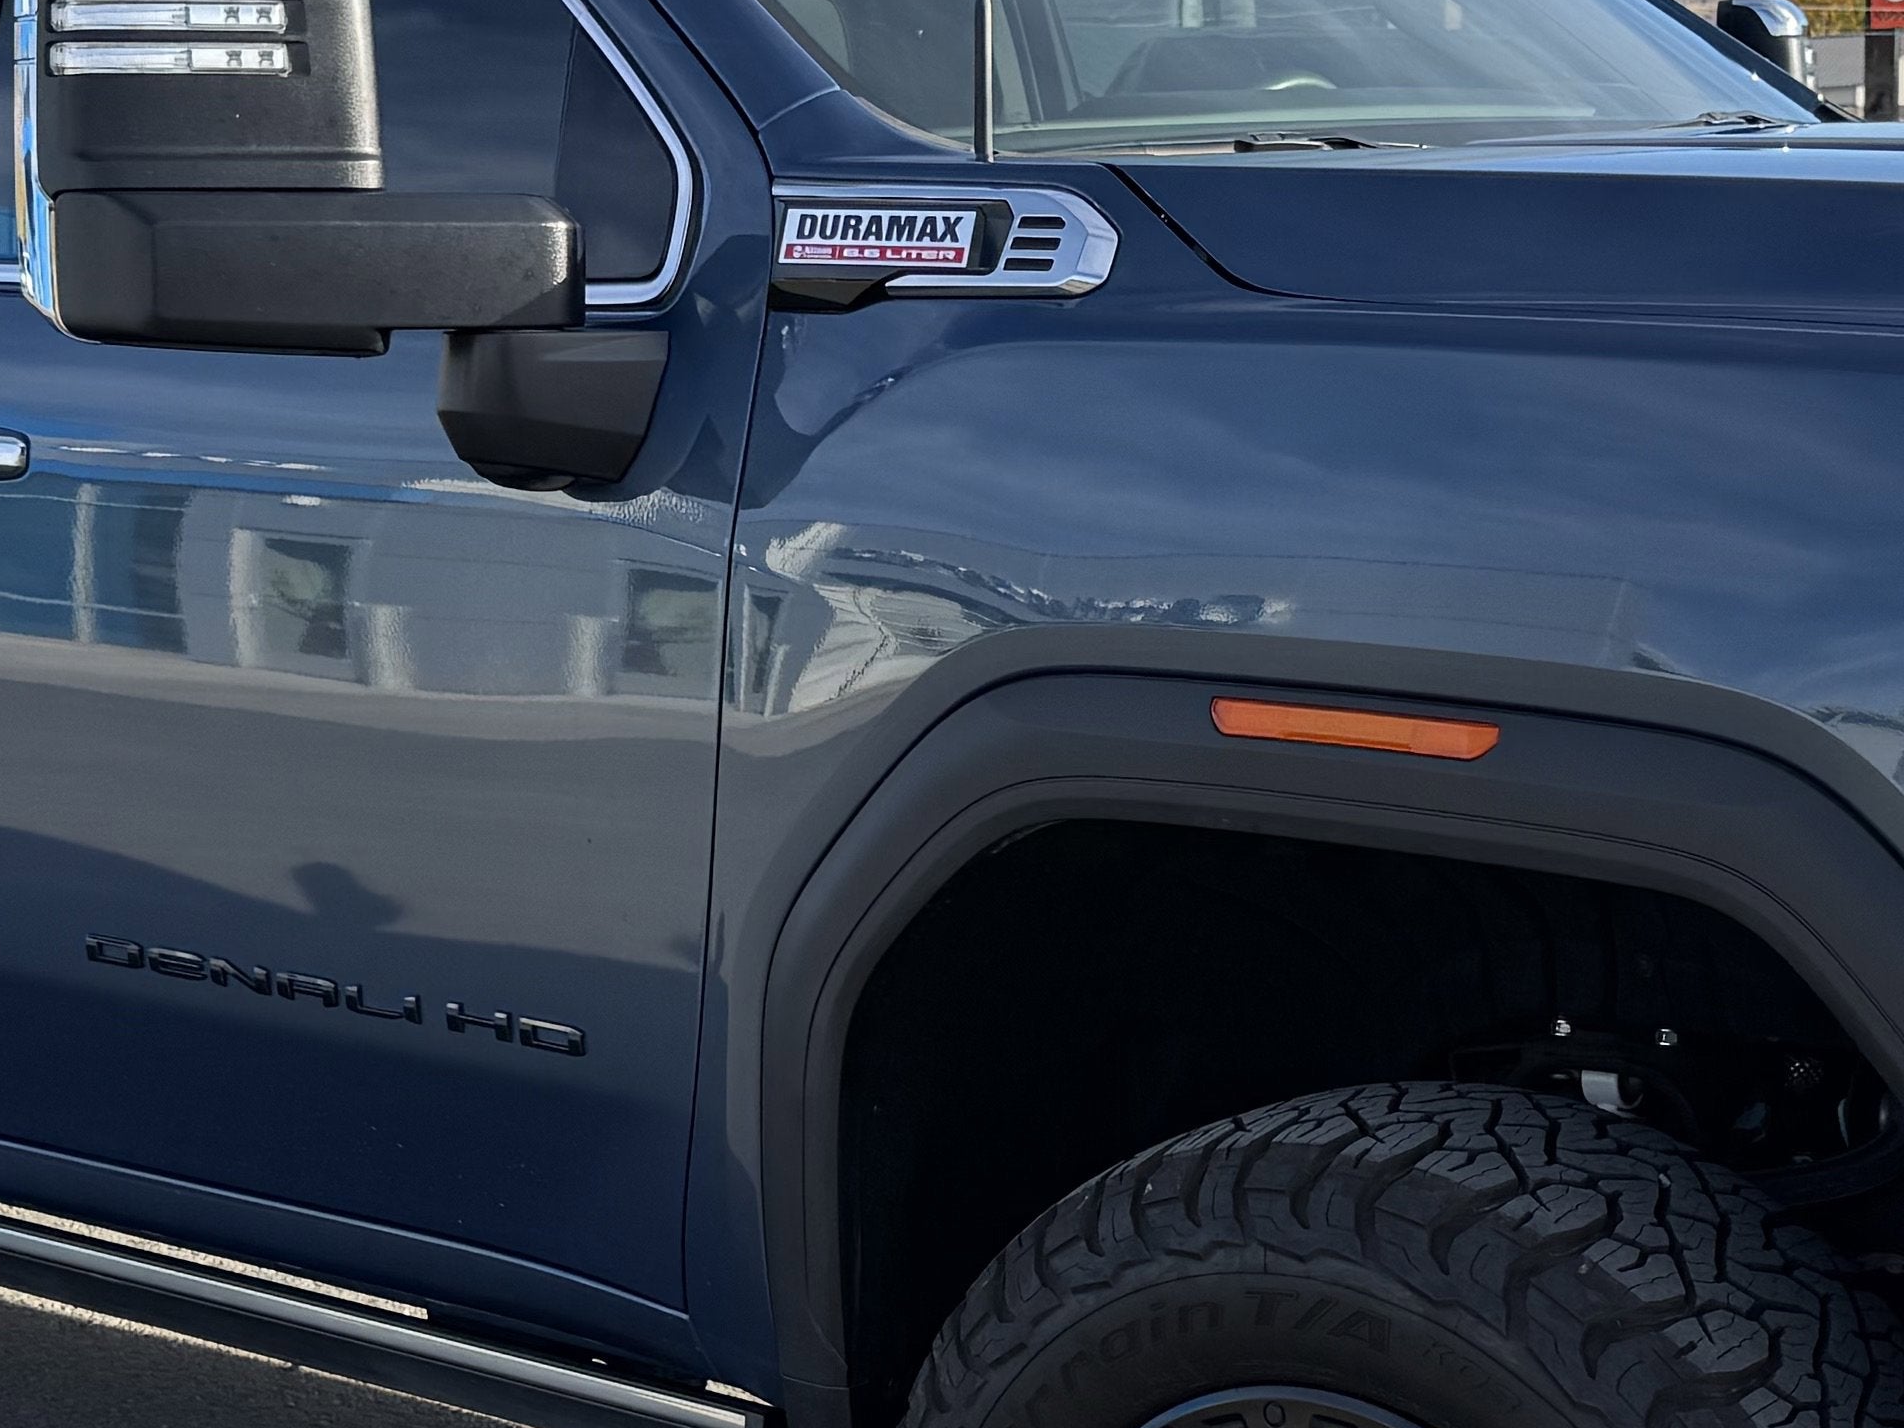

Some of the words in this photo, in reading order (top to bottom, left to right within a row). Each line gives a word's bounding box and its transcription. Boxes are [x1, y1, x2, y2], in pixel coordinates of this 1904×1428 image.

[795, 213, 964, 243] DURAMAX
[842, 247, 881, 259] 6.6
[885, 248, 956, 260] LITER
[85, 933, 423, 1025] DENALI
[444, 1001, 587, 1057] HD
